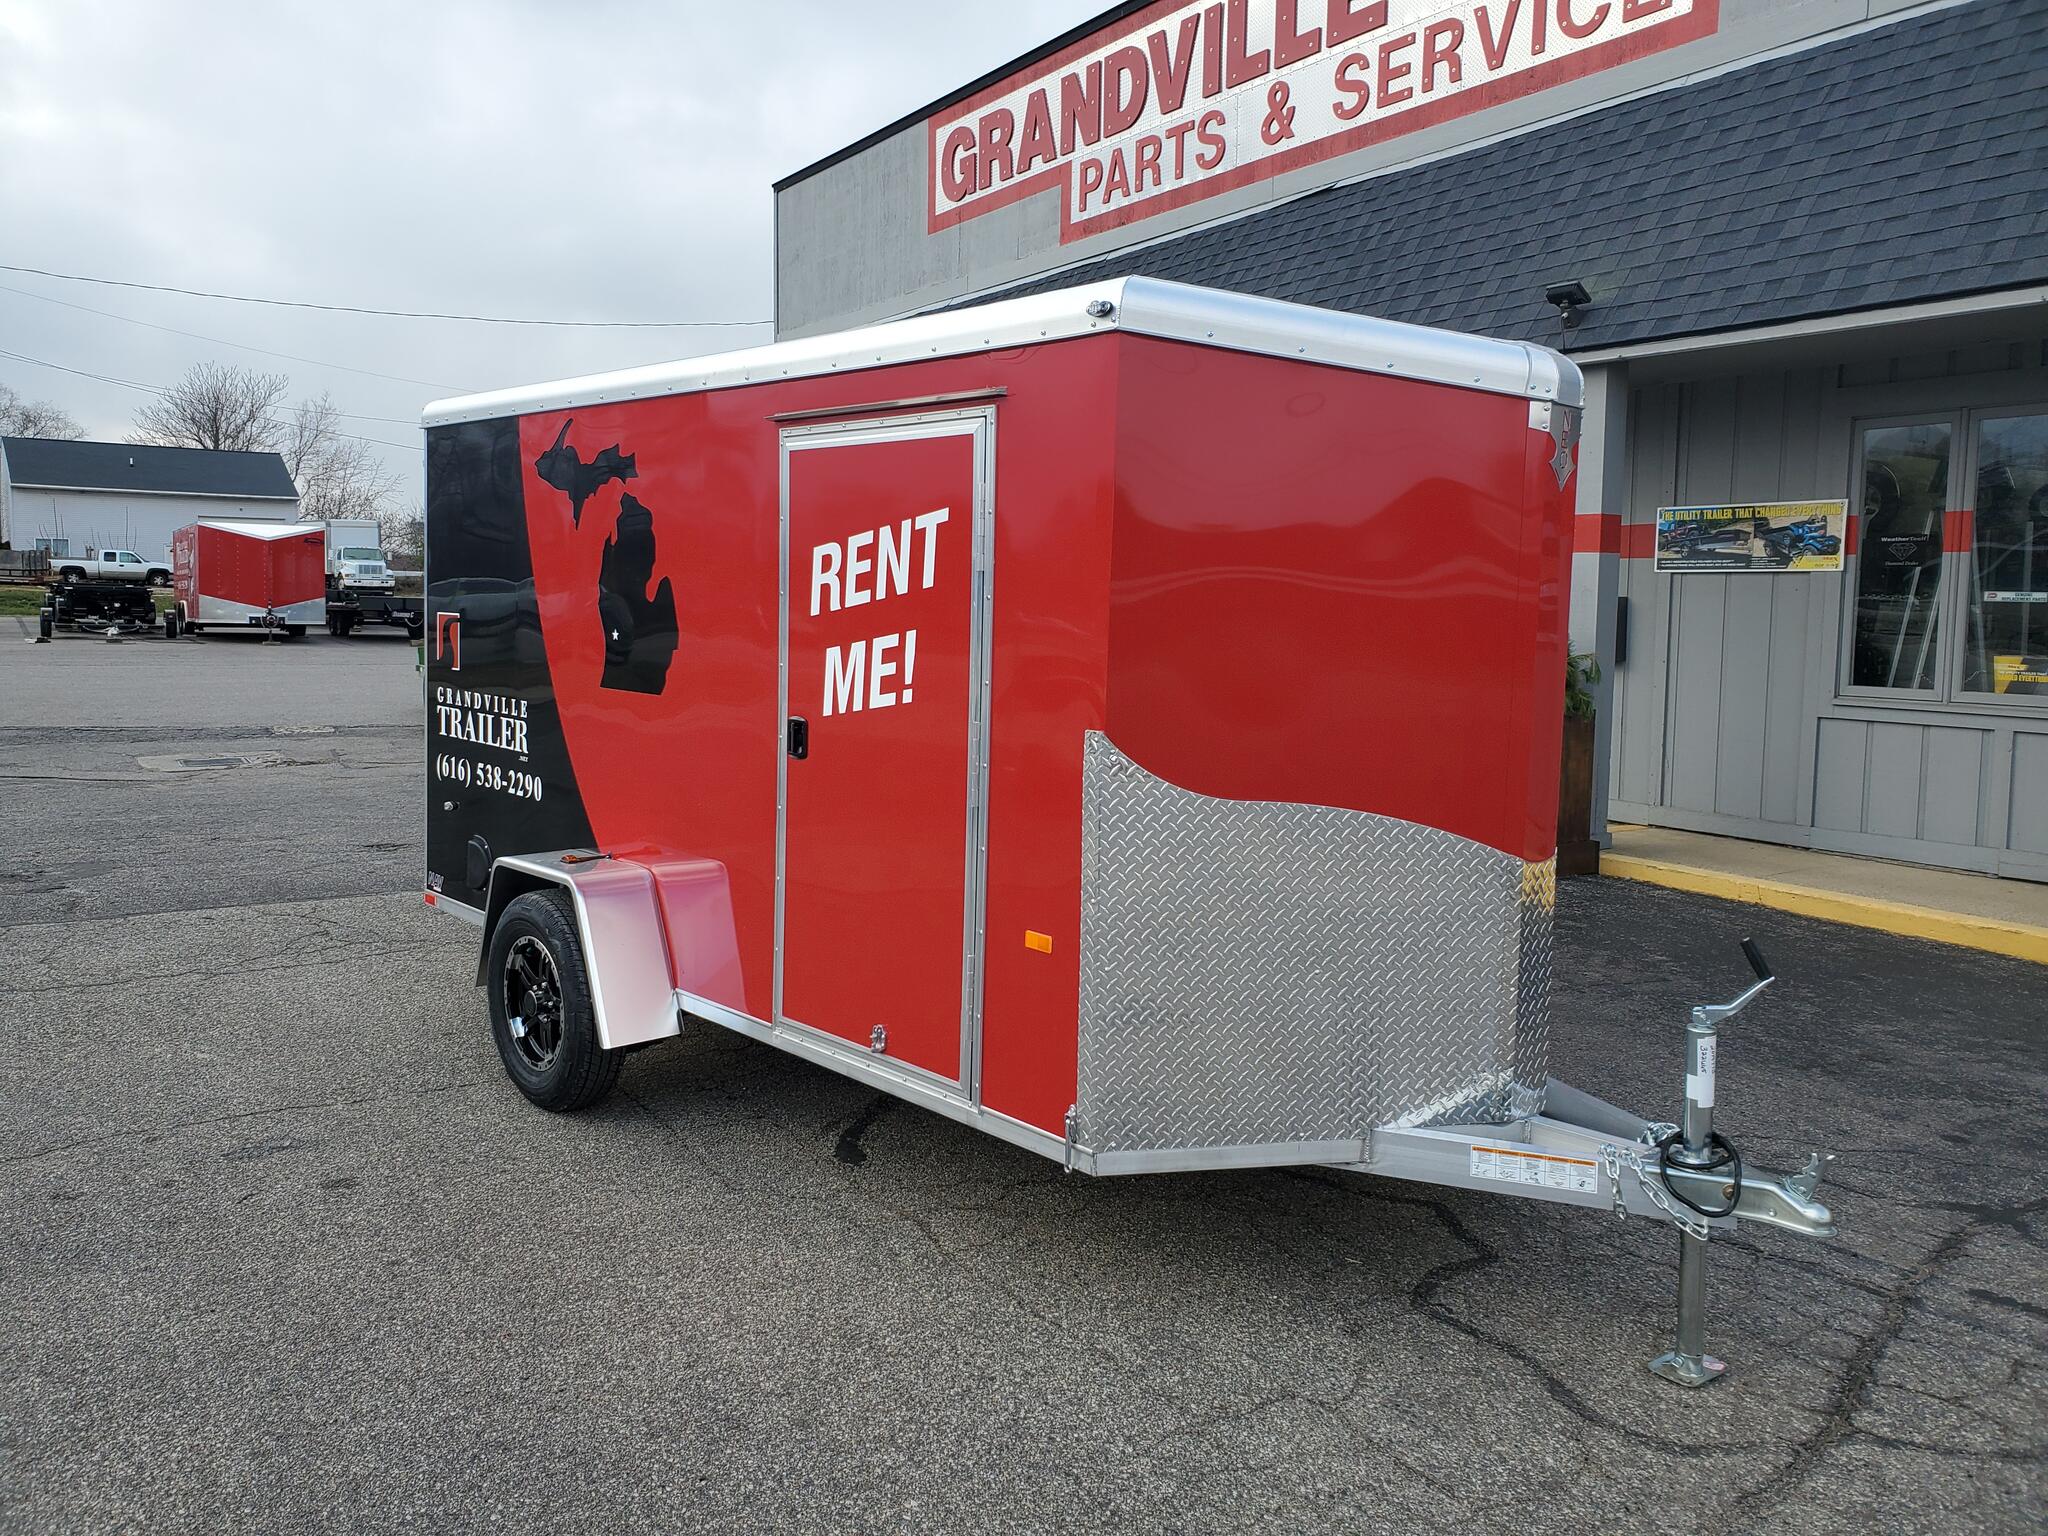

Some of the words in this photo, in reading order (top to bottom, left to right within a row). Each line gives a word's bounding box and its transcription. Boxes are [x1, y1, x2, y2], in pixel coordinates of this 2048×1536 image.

[1079, 109, 1227, 213] PARTS
[1260, 80, 1296, 145] &
[1332, 0, 1673, 121] SERVI
[1662, 511, 1674, 521] THE
[1675, 510, 1701, 520] UTILITY
[1703, 508, 1733, 520] TRAILER
[1734, 507, 1753, 519] THAT
[810, 507, 950, 617] RENT
[822, 629, 917, 717] ME!
[437, 686, 528, 719] GRANDVILLE
[436, 705, 529, 754] TRAILER
[436, 753, 471, 788] (616)
[476, 762, 542, 801] 538-2290
